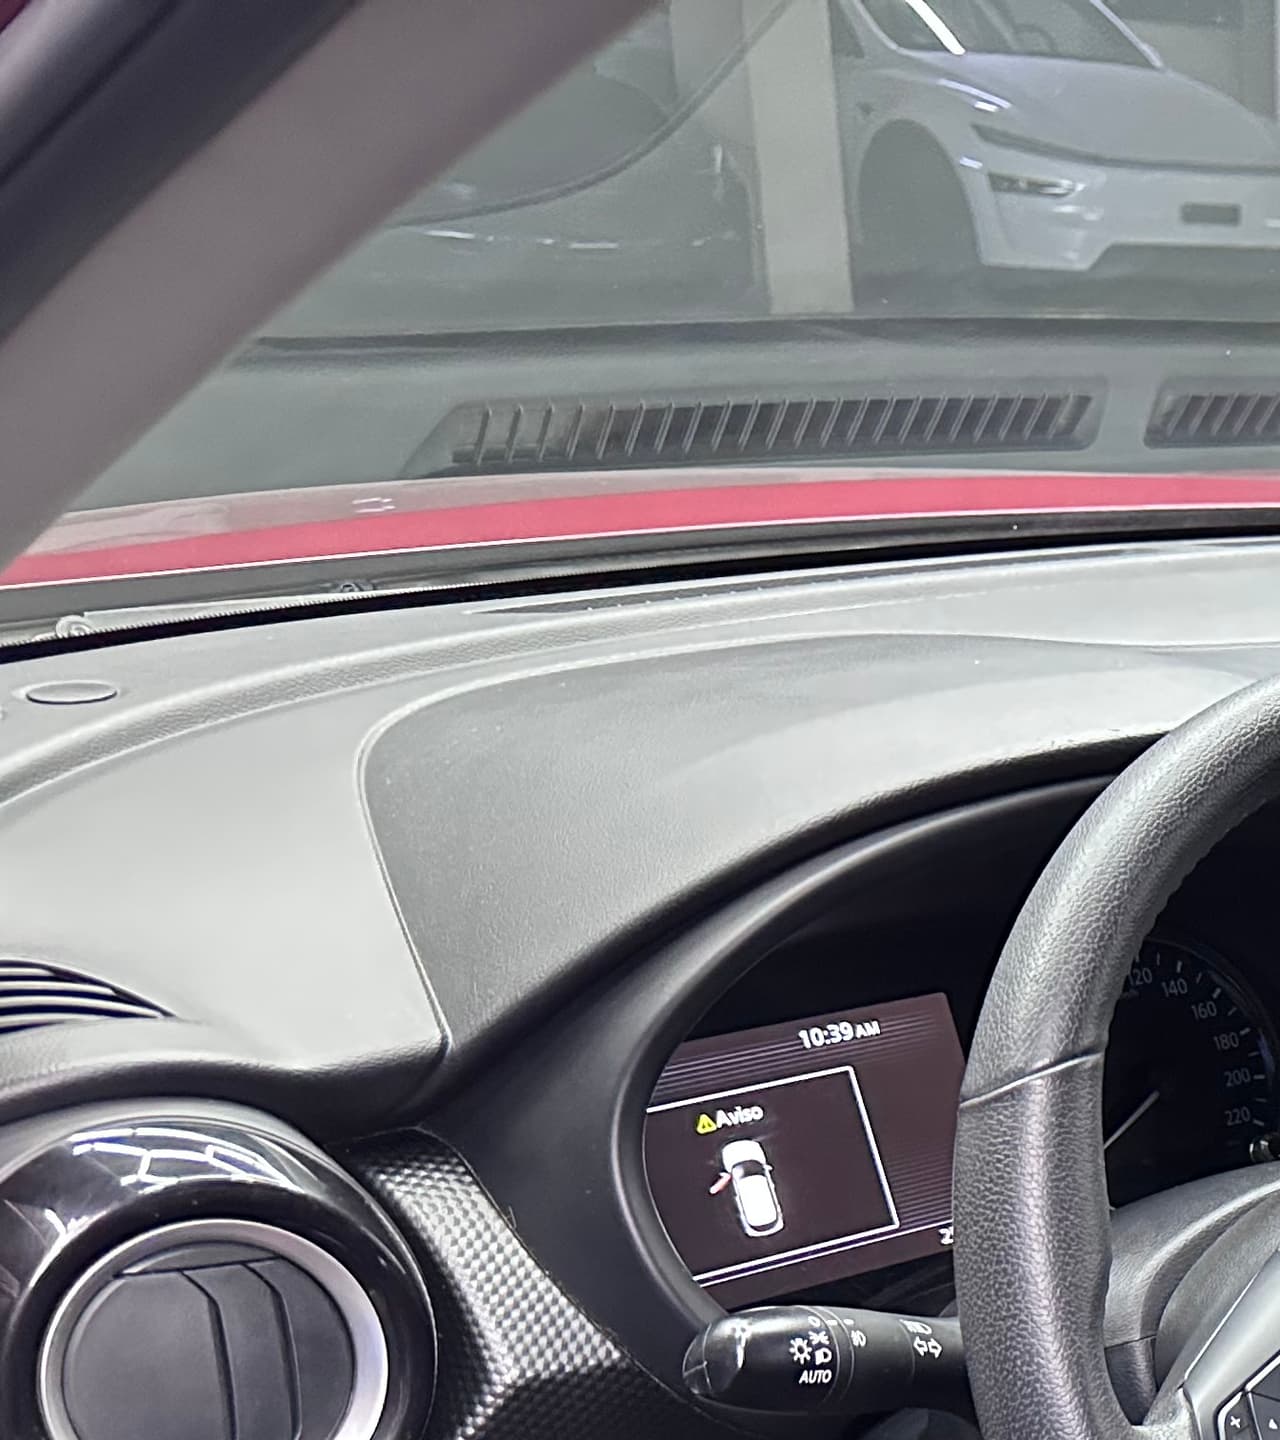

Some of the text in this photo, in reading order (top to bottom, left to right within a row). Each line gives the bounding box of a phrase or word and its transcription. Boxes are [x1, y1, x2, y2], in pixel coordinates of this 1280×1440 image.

[1161, 978, 1188, 998] 140
[1191, 1001, 1217, 1020] 160
[798, 1020, 880, 1049] 10:39 AM
[1213, 1031, 1240, 1050] 180
[1223, 1067, 1250, 1087] 200
[714, 1104, 764, 1129] Aviso
[1224, 1106, 1250, 1126] 220
[938, 1226, 954, 1245] 2
[798, 1369, 832, 1384] AUTO
